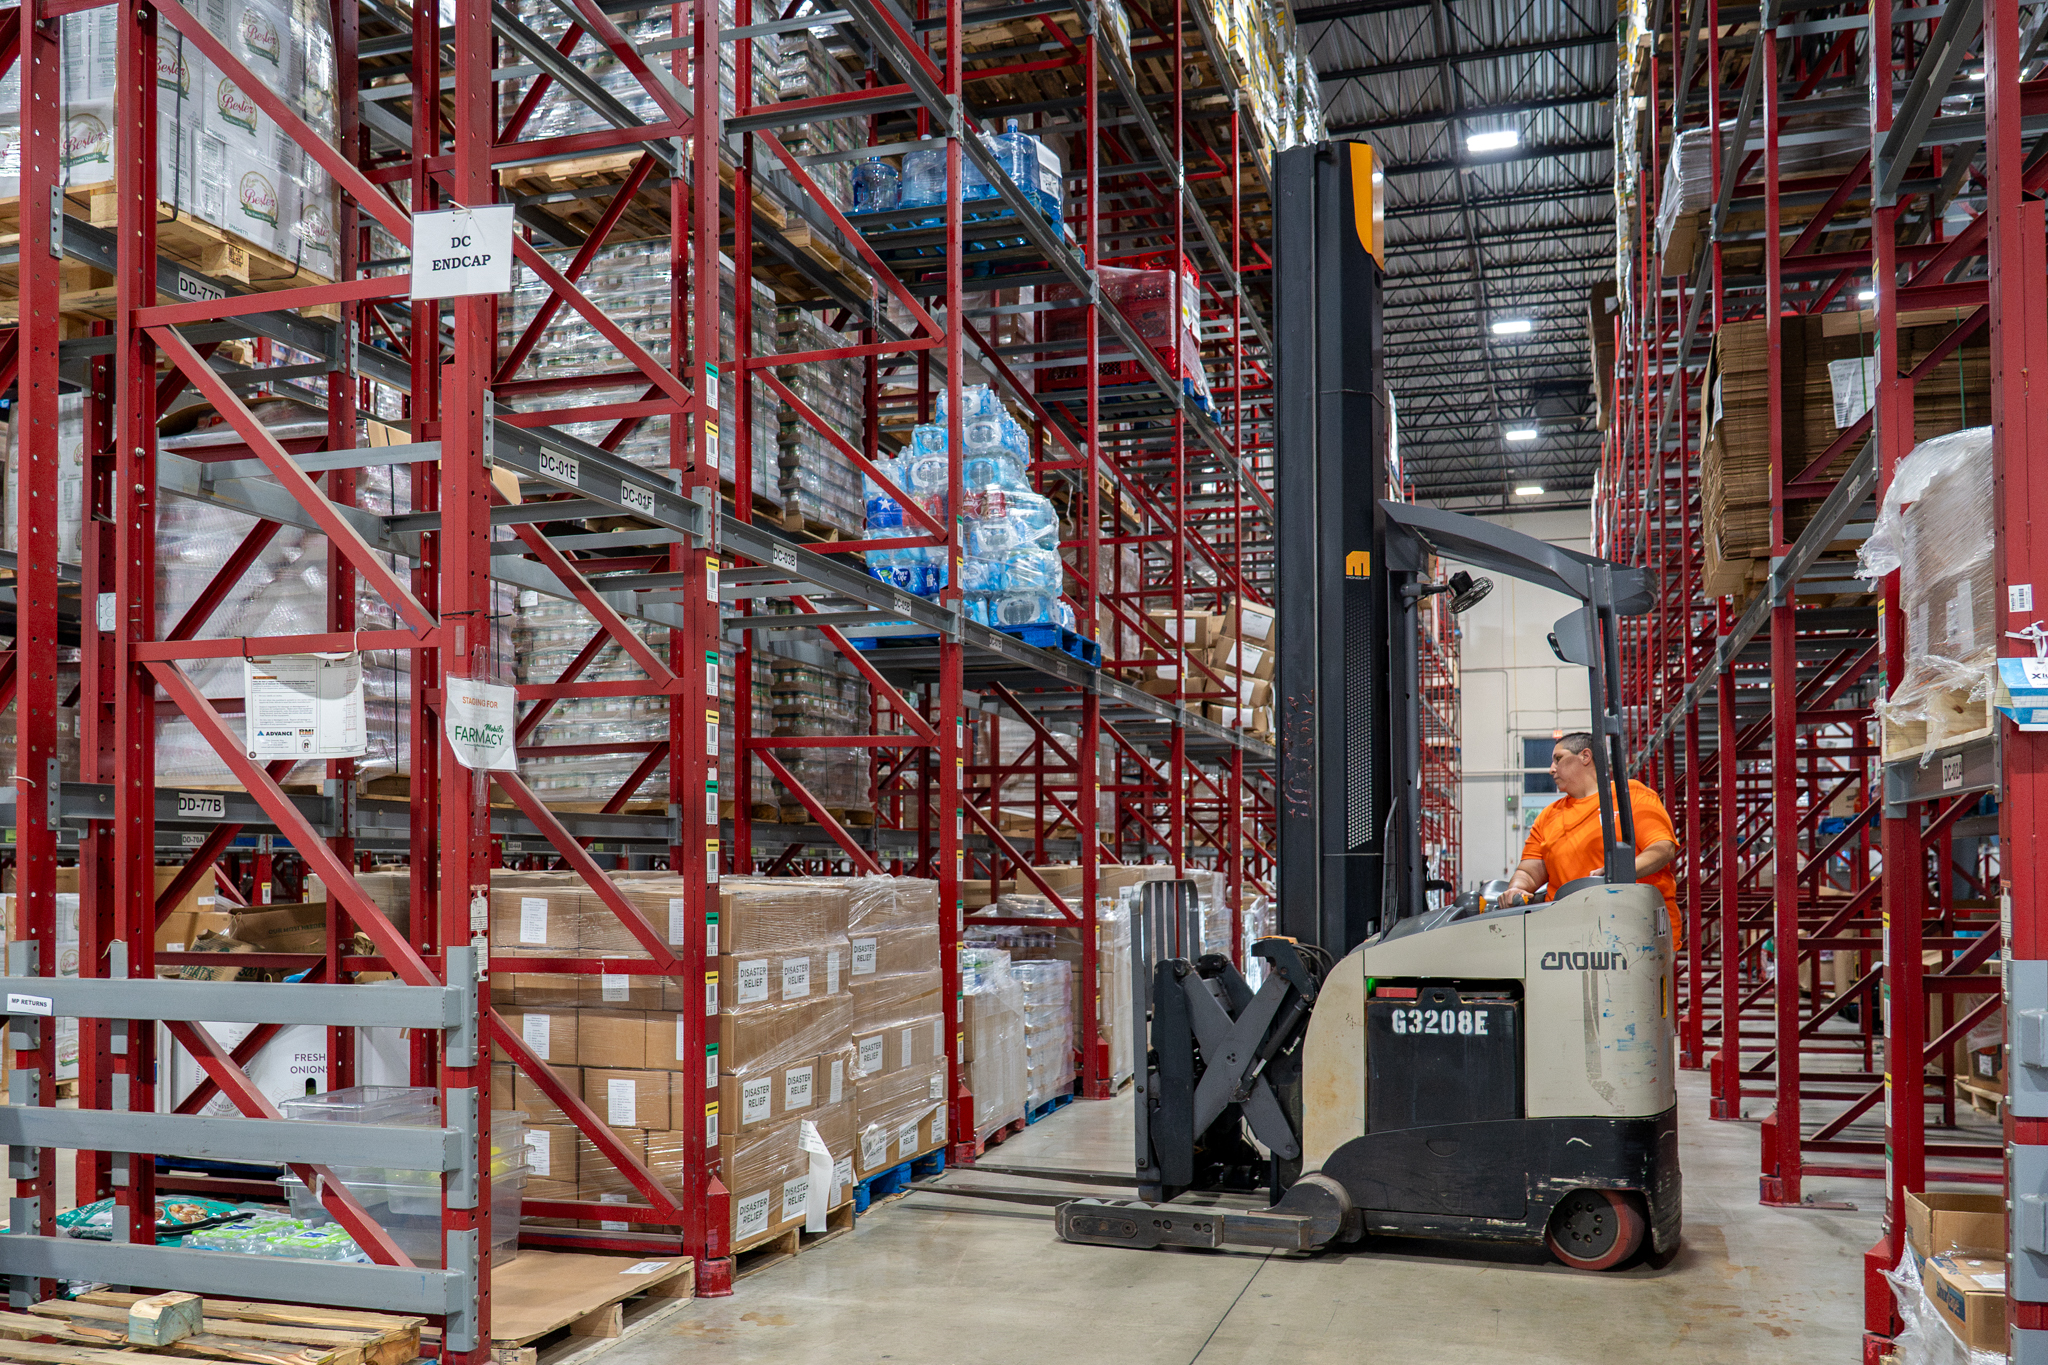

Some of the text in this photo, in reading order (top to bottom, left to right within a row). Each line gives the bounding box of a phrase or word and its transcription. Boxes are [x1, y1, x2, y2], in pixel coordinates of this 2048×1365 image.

[450, 235, 472, 249] DC
[432, 254, 491, 271] ENDCAP
[540, 452, 577, 481] DC-01E
[773, 547, 796, 567] DC-03B
[462, 696, 498, 709] STAGING FOR
[455, 725, 504, 746] FARMACY
[178, 797, 222, 812] DD-77B
[853, 943, 876, 954] DISASTER
[856, 953, 872, 963] RELIEF
[740, 966, 767, 978] DISASTER
[784, 963, 809, 976] DISASTER
[743, 976, 763, 988] RELIEF
[787, 974, 805, 986] RELIEF
[20, 999, 47, 1007] RETURNS
[1391, 1009, 1489, 1036] G3208E
[860, 1041, 882, 1054] DISASTER
[294, 1053, 326, 1062] FRESH
[863, 1051, 879, 1063] RELIEF
[787, 1072, 812, 1086] DISASTER
[744, 1084, 770, 1100] DISASTER
[790, 1084, 808, 1096] RELIEF
[748, 1096, 766, 1109] RELIEF
[903, 1134, 915, 1146] RELIEF
[788, 1192, 806, 1206] RELIEF
[739, 1197, 768, 1216] DISASTER
[742, 1209, 763, 1225] RELIEF
